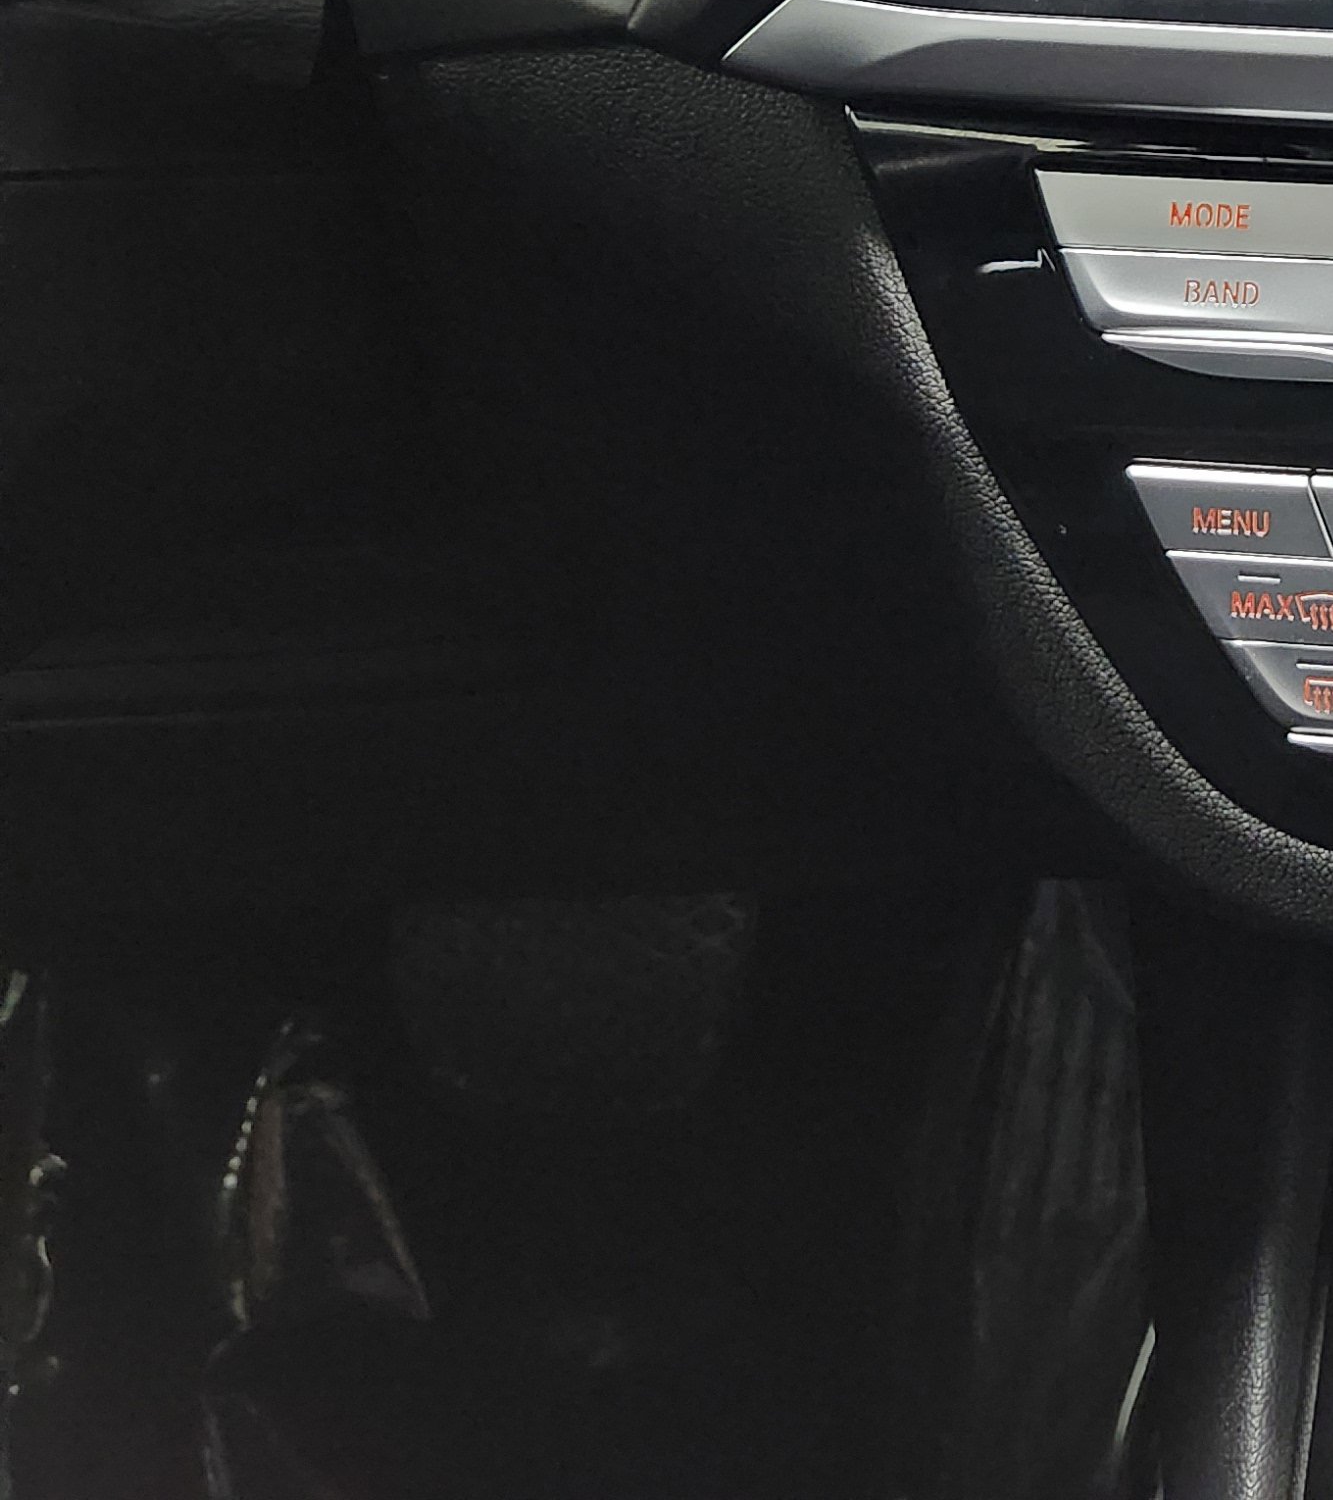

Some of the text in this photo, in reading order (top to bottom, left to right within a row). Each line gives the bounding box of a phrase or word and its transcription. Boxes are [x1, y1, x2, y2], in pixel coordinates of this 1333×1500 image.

[1169, 202, 1251, 230] MODE
[1184, 279, 1260, 308] BAND
[1192, 507, 1271, 538] MENU
[1231, 591, 1295, 622] MAX
